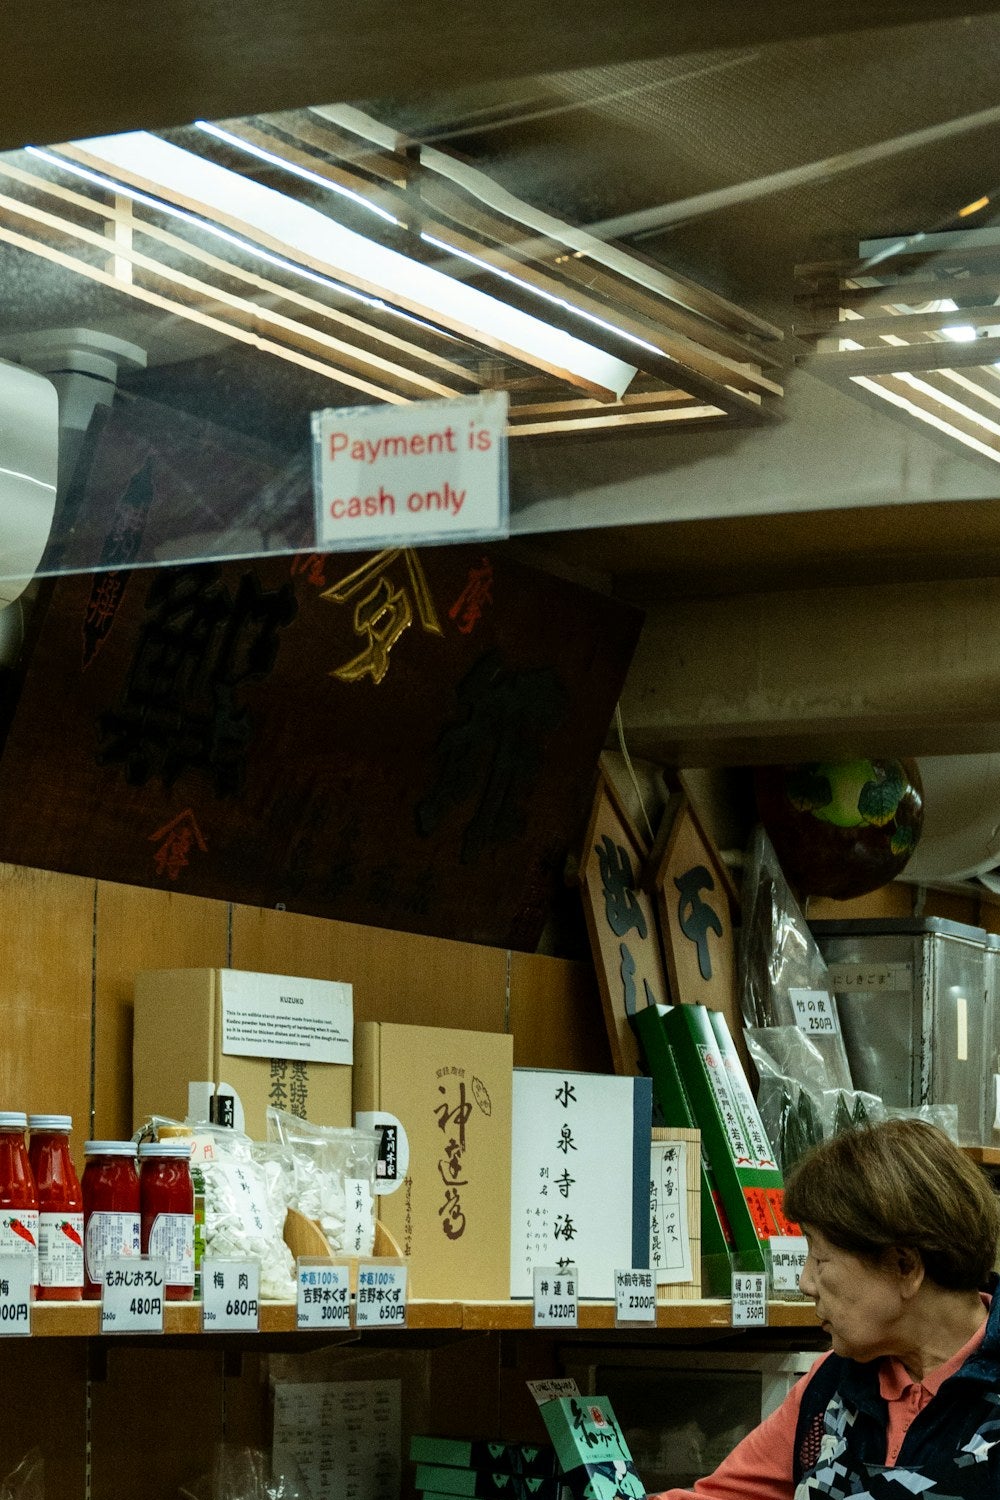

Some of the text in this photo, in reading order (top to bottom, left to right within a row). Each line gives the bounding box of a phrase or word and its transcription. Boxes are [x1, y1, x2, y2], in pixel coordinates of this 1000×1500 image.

[329, 421, 492, 464] Payment is
[329, 482, 466, 519] cash only
[105, 1270, 163, 1287] もみじおろし
[303, 1287, 348, 1304] 吉野本くず
[358, 1287, 402, 1304] 吉野本くず
[0, 1302, 28, 1321] 00円
[129, 1297, 161, 1316] 480円
[225, 1299, 258, 1317] 680円
[321, 1304, 350, 1321] 3000円
[379, 1304, 405, 1320] 650円
[548, 1303, 575, 1319] 4320円
